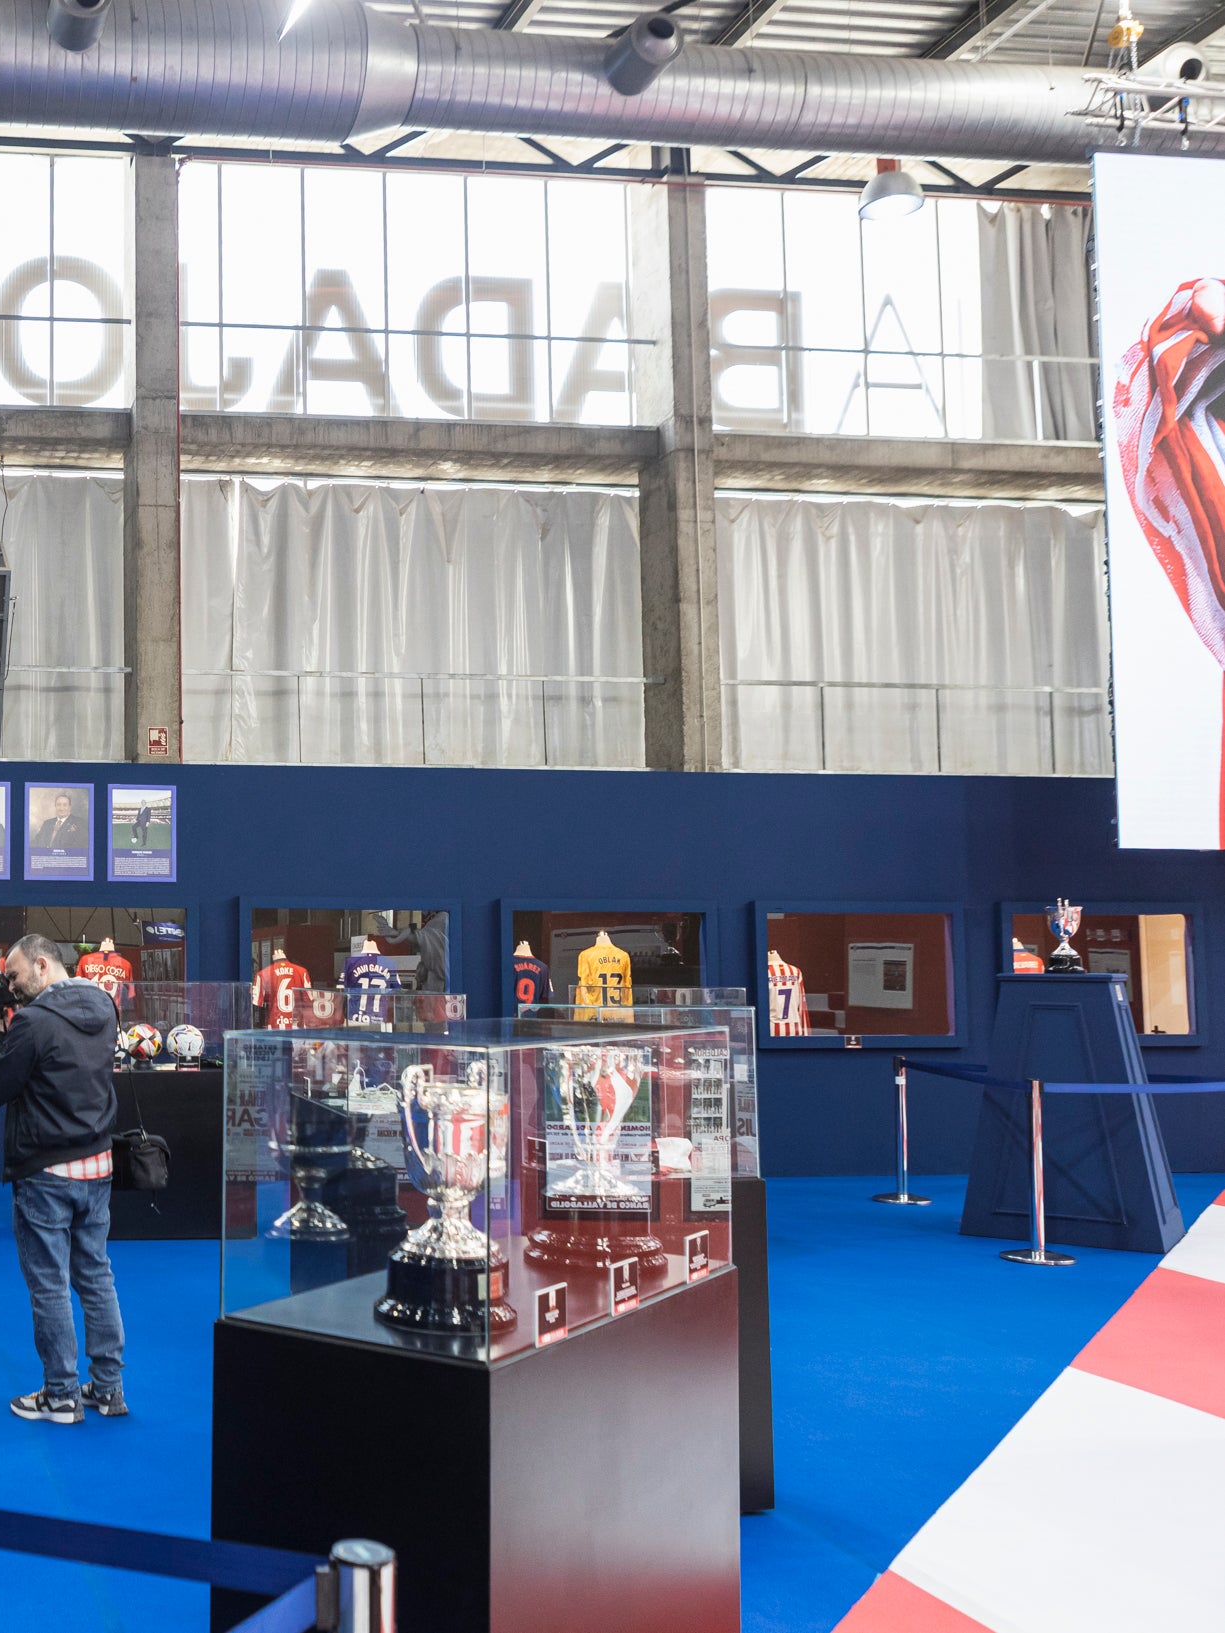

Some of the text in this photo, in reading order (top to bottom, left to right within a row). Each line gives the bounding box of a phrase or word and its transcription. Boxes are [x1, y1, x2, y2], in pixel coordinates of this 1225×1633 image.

[84, 964, 126, 978] DIEGO COSTA
[274, 967, 294, 977] KOKE
[353, 964, 369, 978] JAVI
[599, 957, 621, 965] OBLAK
[277, 978, 295, 1013] 6
[357, 977, 387, 1012] 17
[517, 978, 535, 1005] 9
[598, 973, 623, 1006] 13
[778, 988, 792, 1019] 7
